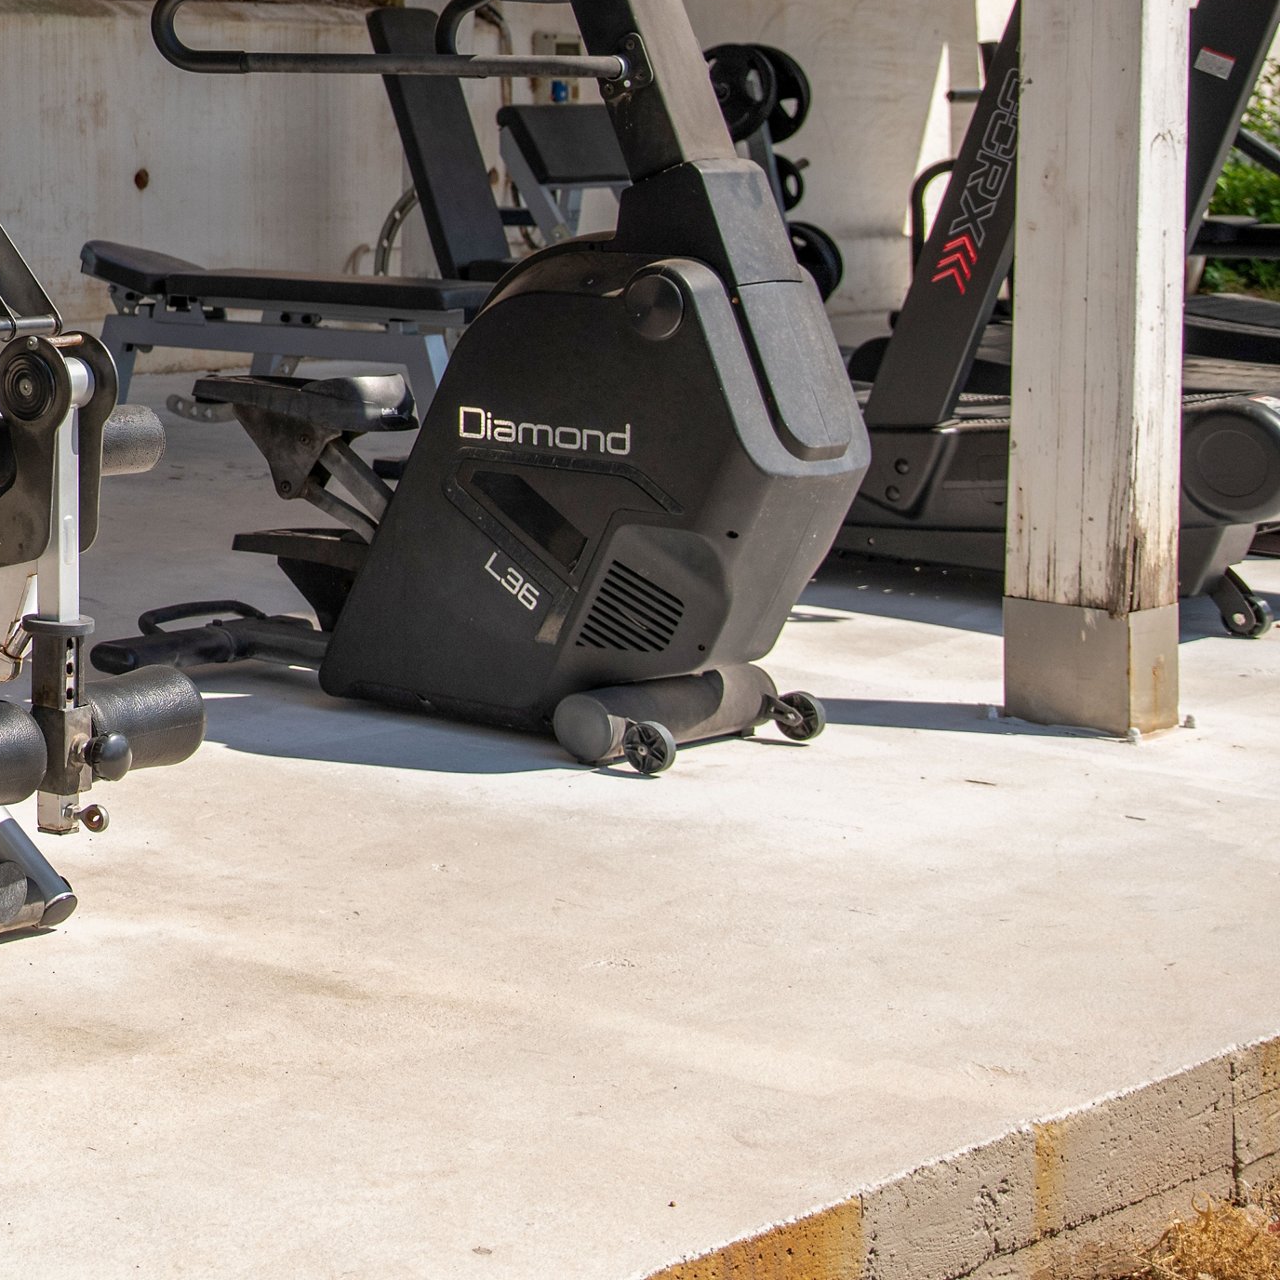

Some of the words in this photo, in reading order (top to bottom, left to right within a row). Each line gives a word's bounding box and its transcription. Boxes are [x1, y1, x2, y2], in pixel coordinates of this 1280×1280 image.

[948, 67, 1019, 249] OORX
[458, 406, 631, 456] Diamond
[484, 551, 540, 611] L36
